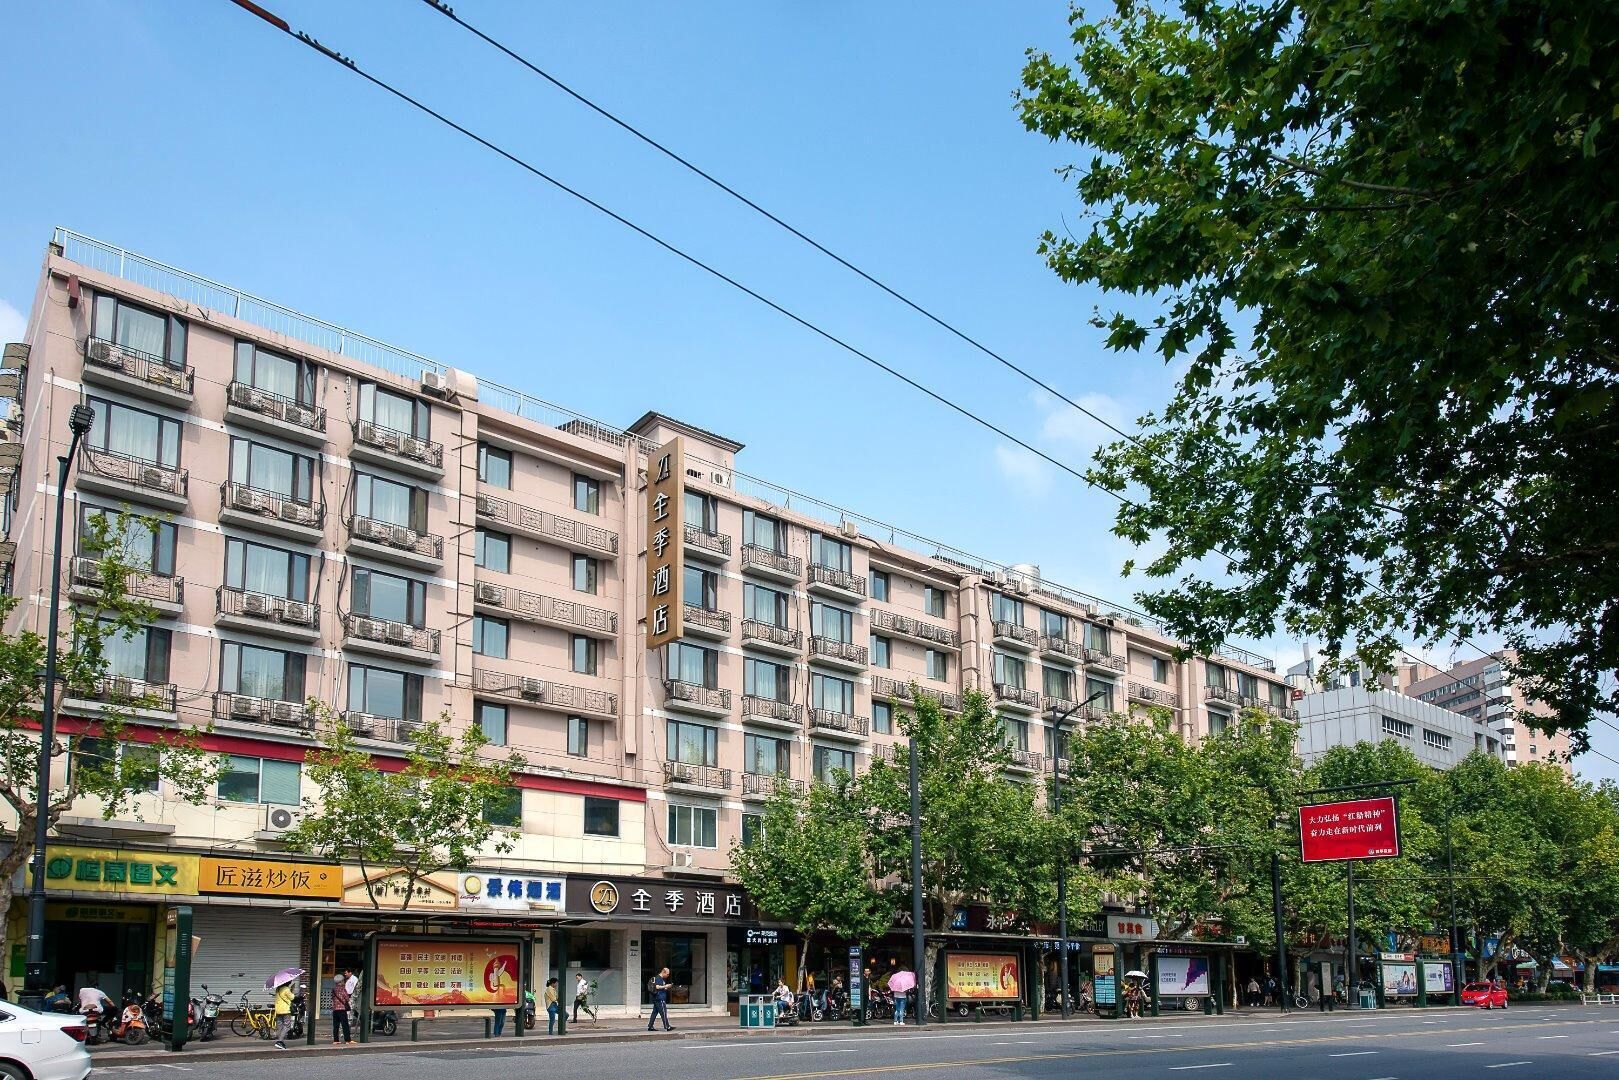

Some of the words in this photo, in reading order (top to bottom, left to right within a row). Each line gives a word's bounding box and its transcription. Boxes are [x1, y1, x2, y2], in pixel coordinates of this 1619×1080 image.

[652, 492, 670, 636] 全季酒店
[1310, 823, 1382, 837] 奋力走在新时代前列
[215, 865, 311, 889] 匠滋炒饭
[631, 888, 742, 916] 全季酒店
[417, 953, 429, 961] 民主
[399, 967, 412, 975] 自由
[433, 967, 446, 975] 公正
